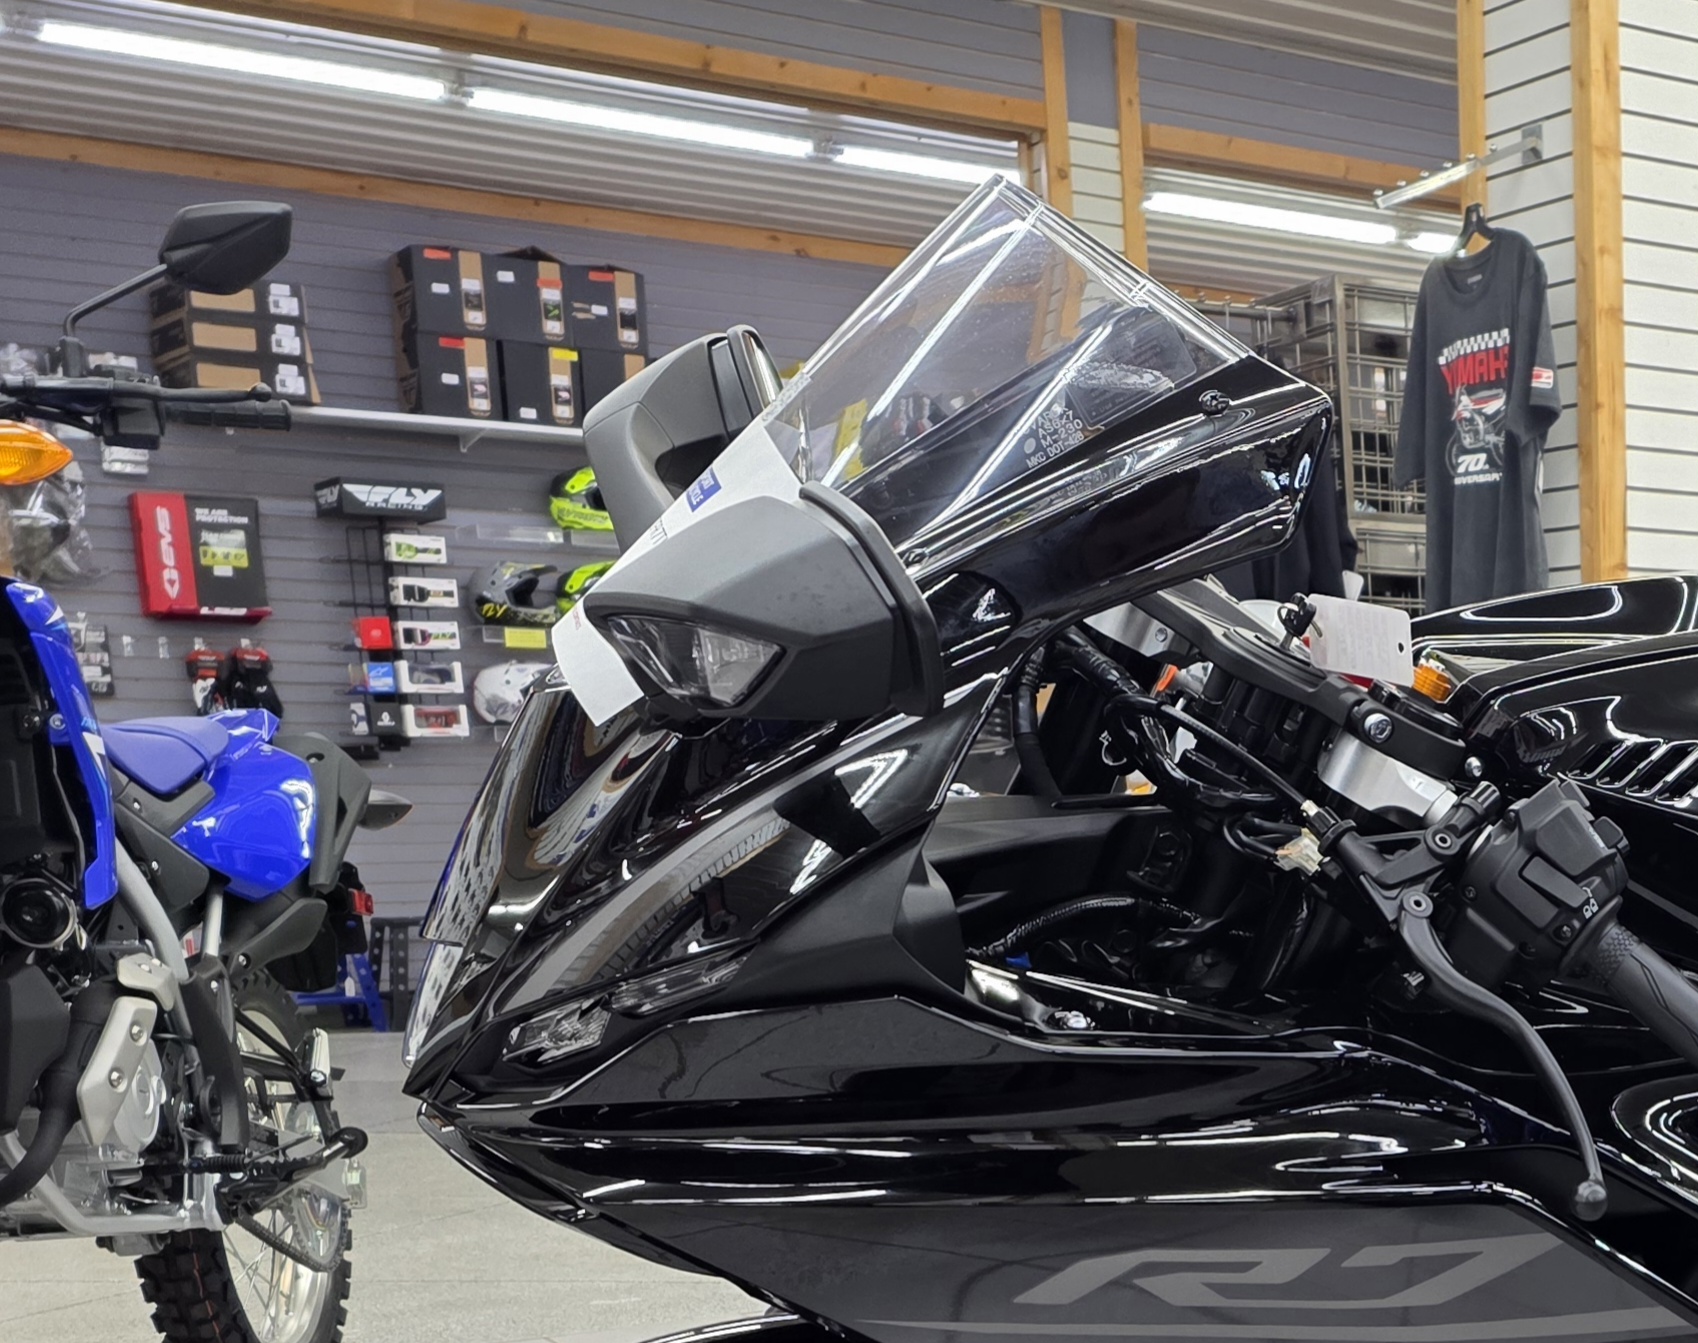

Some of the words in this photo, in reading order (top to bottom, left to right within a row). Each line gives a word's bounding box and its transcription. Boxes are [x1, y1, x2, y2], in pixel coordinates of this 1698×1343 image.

[1040, 418, 1083, 449] M-230
[1025, 451, 1047, 468] MKC
[342, 483, 443, 505] FLY
[155, 505, 176, 568] EVS
[1013, 1232, 1566, 1308] R7
